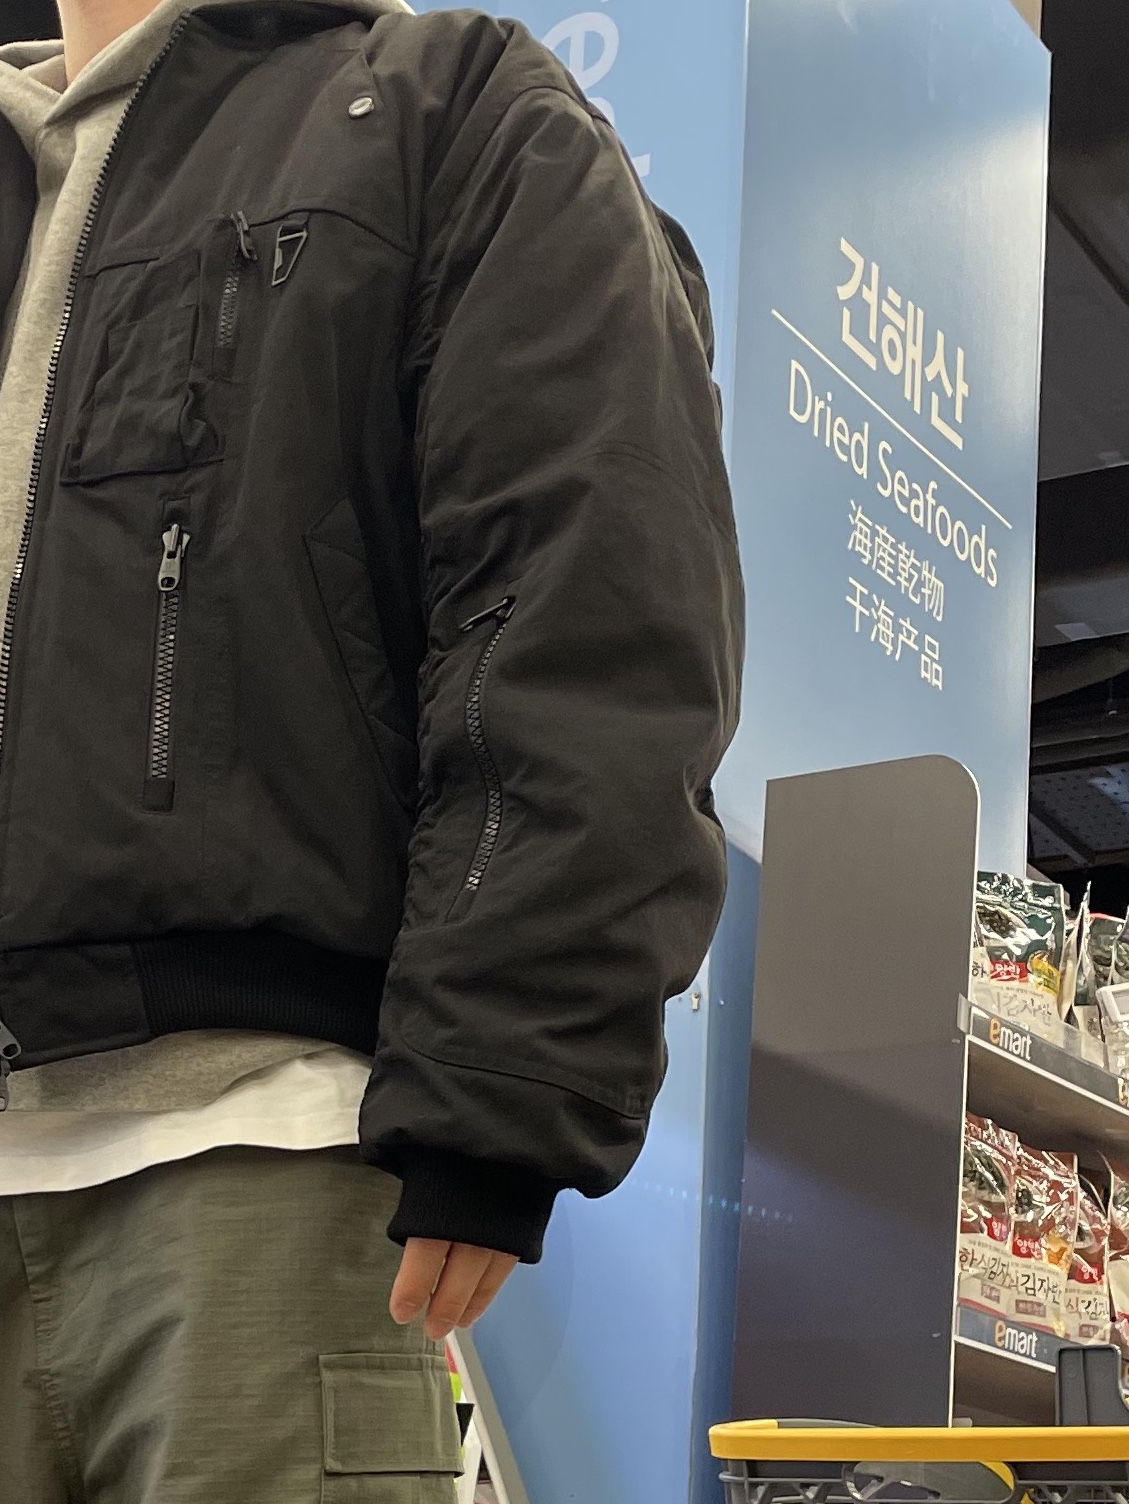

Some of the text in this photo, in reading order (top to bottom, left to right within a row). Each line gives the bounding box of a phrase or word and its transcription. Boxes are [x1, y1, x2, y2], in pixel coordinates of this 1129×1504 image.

[837, 237, 969, 450] 건해산
[789, 359, 997, 587] Dried Seafoods
[848, 499, 944, 622] 海産乾物
[845, 576, 943, 691] 干海产品
[988, 1018, 1032, 1061] emart
[994, 1319, 1039, 1359] emart
